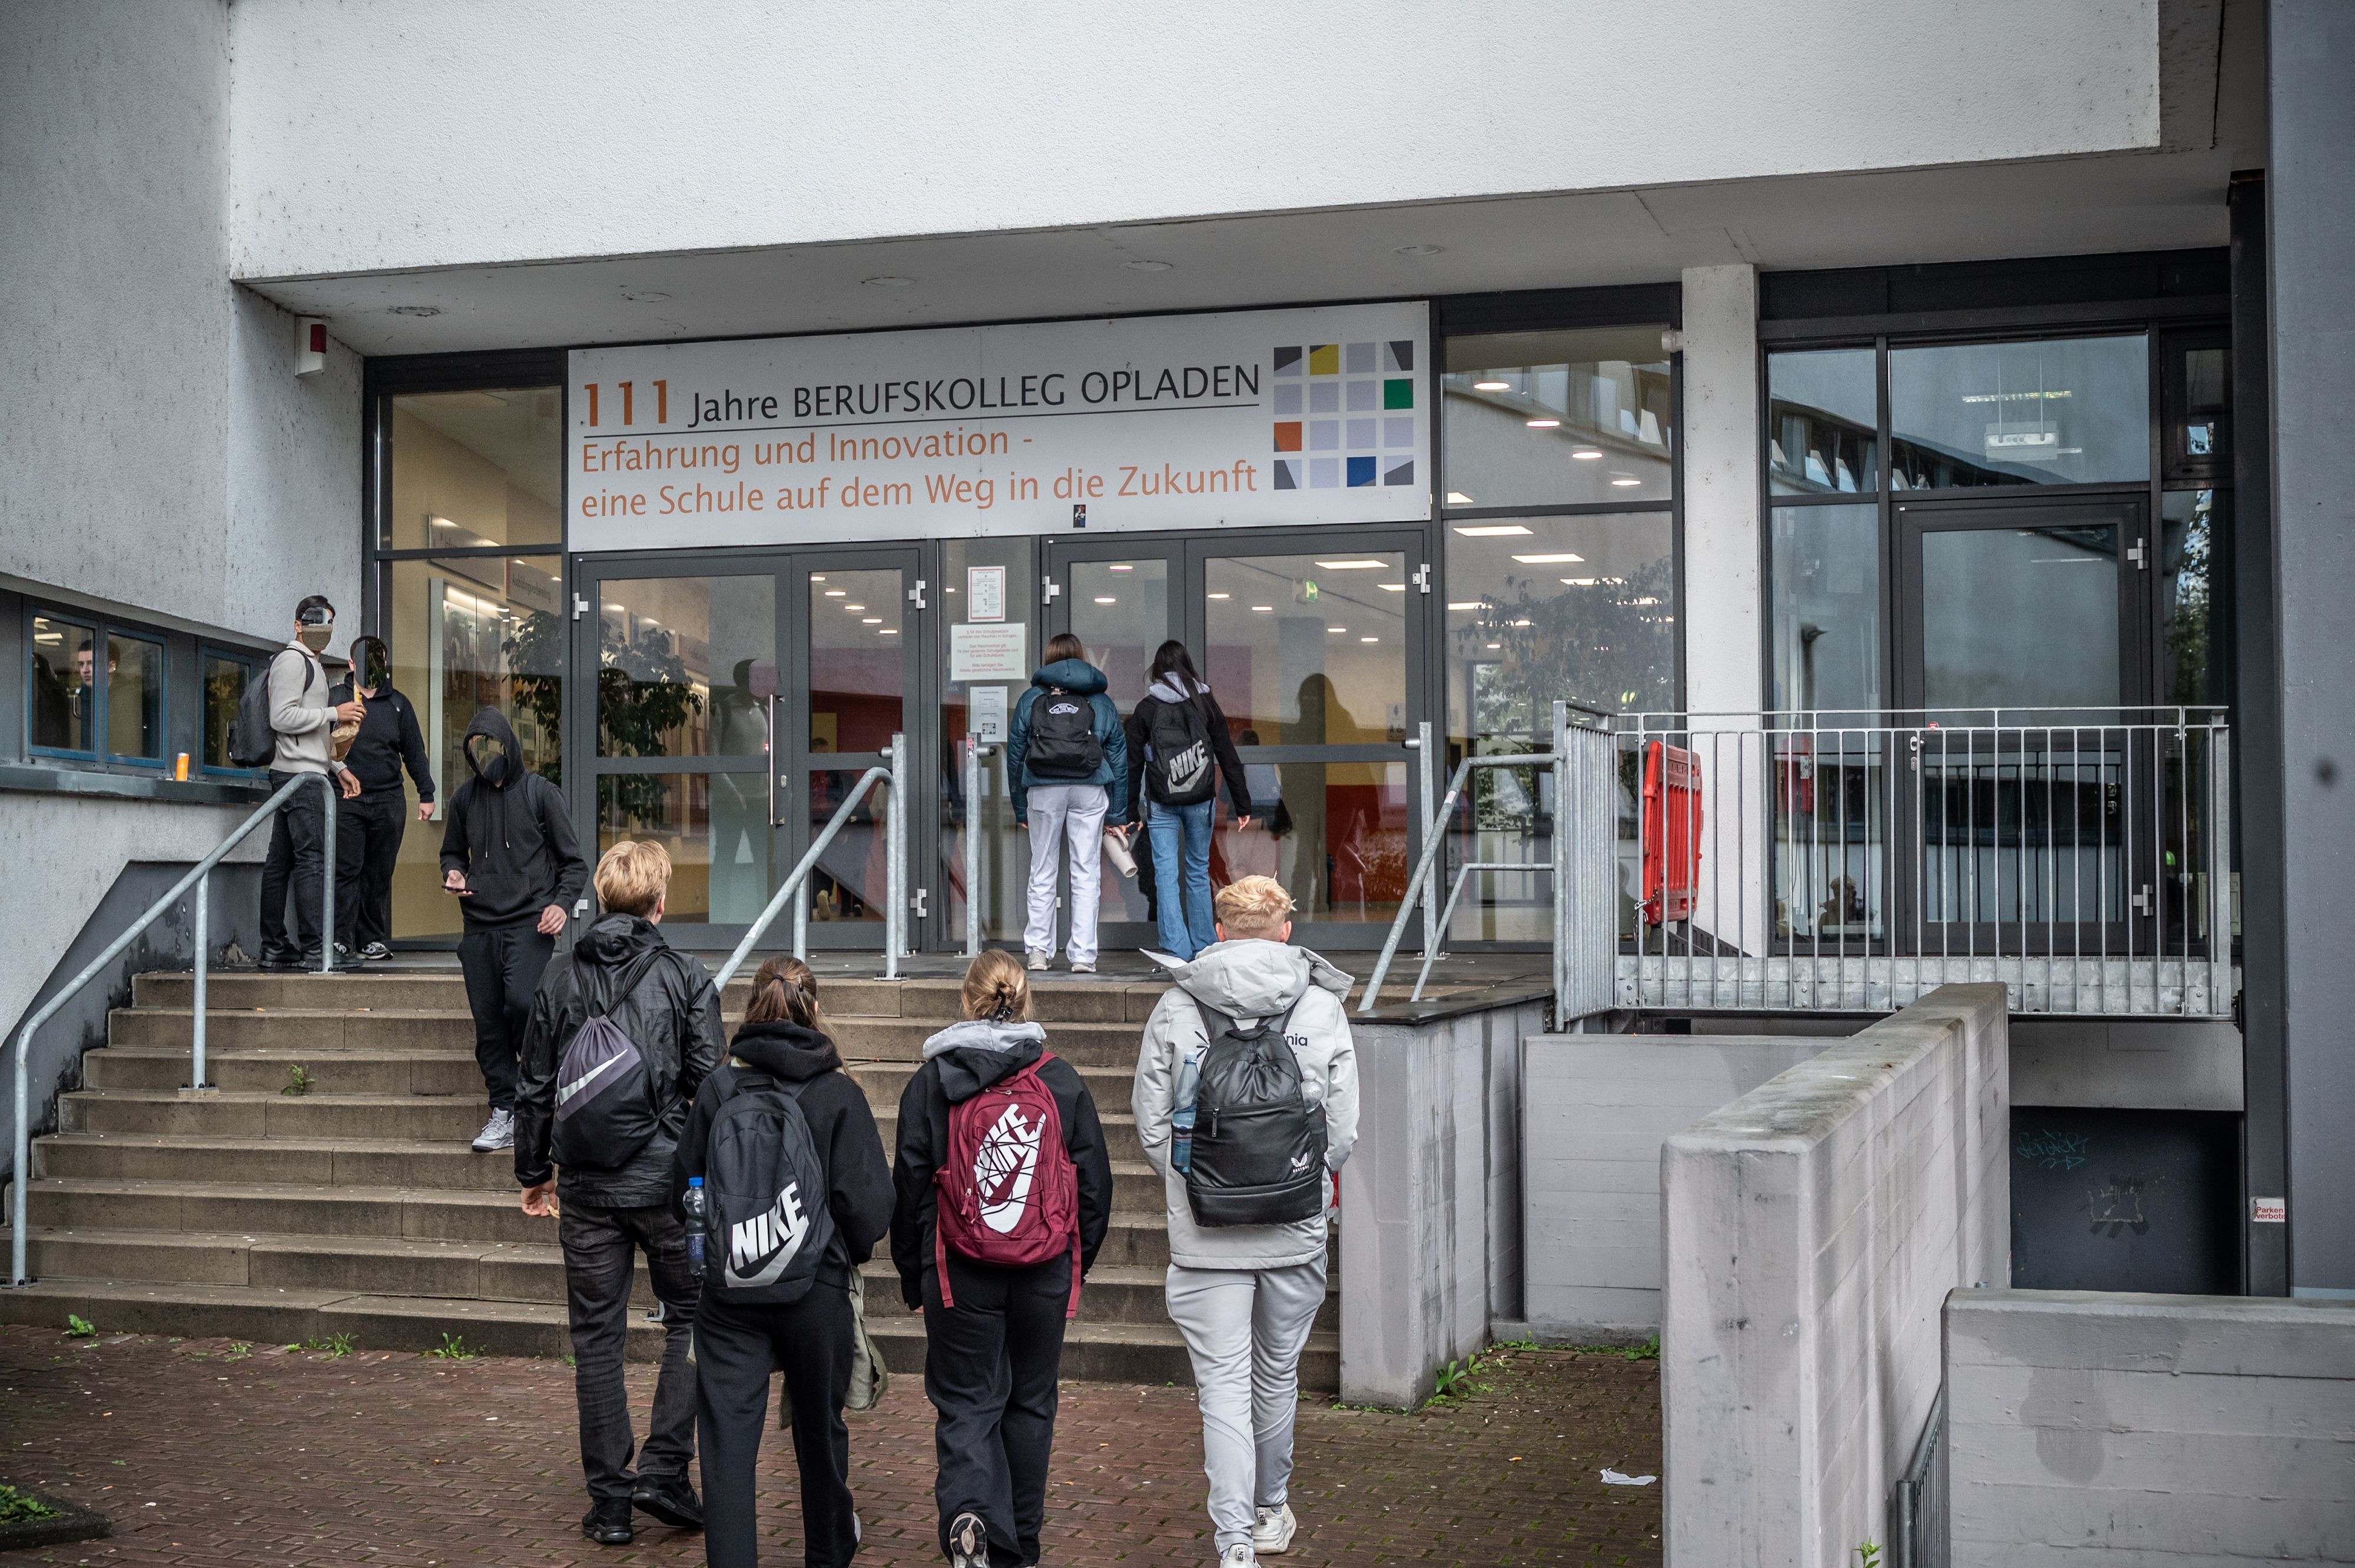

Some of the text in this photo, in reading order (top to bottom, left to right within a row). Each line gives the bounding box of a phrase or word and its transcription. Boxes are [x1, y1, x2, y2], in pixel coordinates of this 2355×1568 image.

[583, 364, 1259, 428] 111 Jahre BERUFSKOLLEG OPLADEN
[583, 440, 739, 474] Erfahrung
[755, 433, 815, 465] und
[831, 427, 1008, 461] Innovation
[582, 459, 1257, 517] eine Schule auf dem Weg in die Zukunft
[1169, 739, 1208, 782] NIKE
[973, 1103, 1036, 1201] NIKE
[731, 1180, 807, 1270] NIKE
